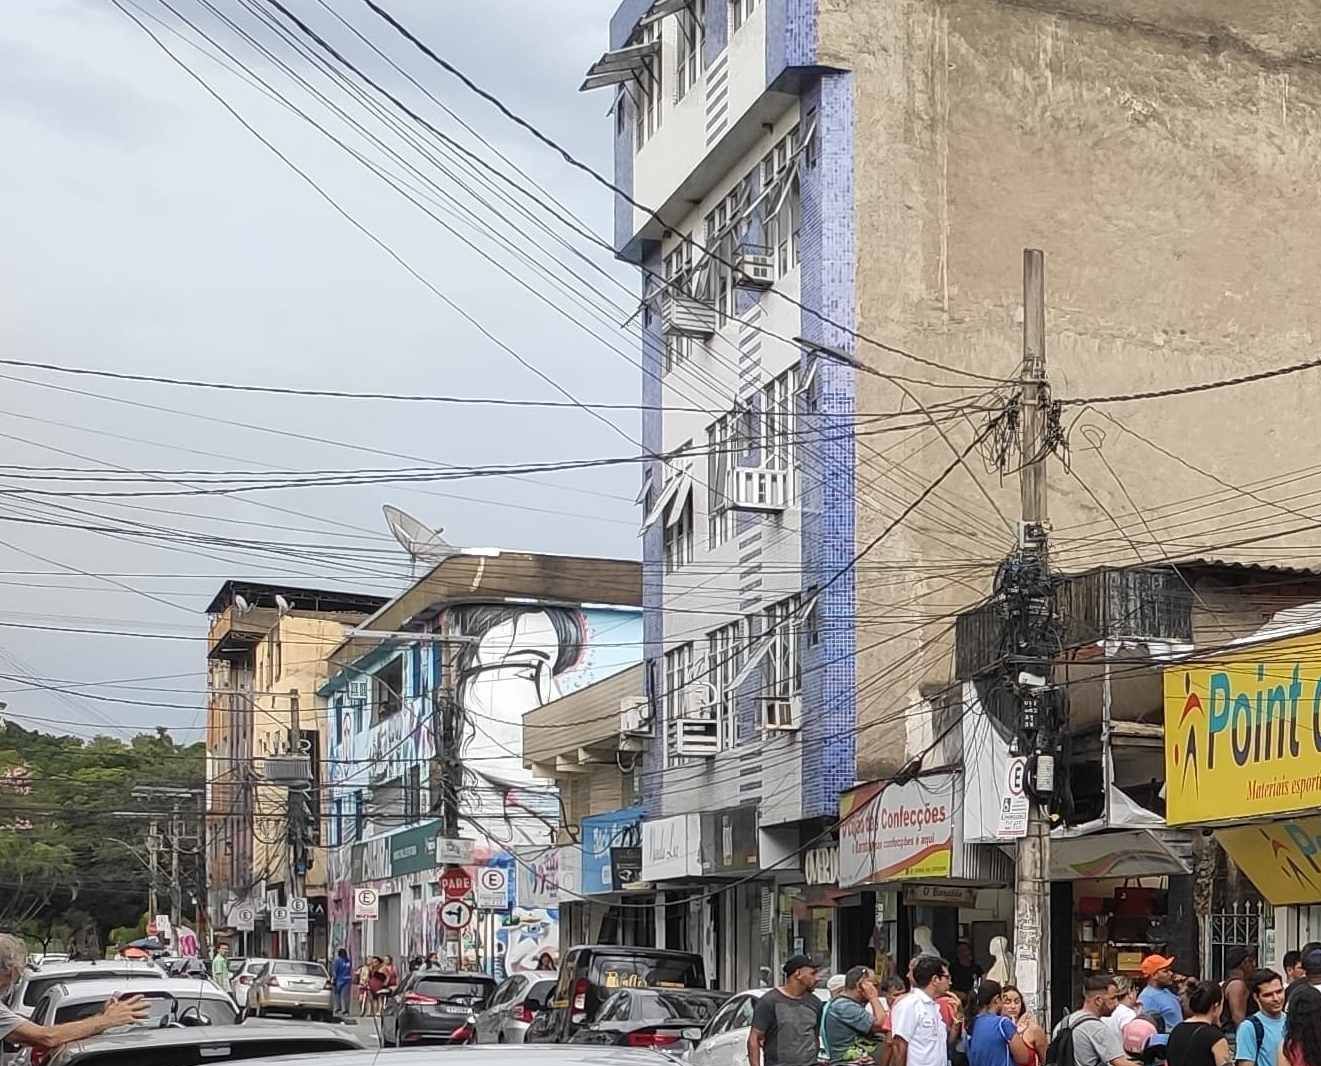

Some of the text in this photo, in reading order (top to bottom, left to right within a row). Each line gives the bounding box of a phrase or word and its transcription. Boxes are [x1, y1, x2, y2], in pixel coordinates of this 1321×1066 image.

[1207, 662, 1303, 770] Point
[1246, 775, 1290, 801] Materiais
[881, 803, 946, 832] Confecções
[442, 878, 472, 890] PARE
